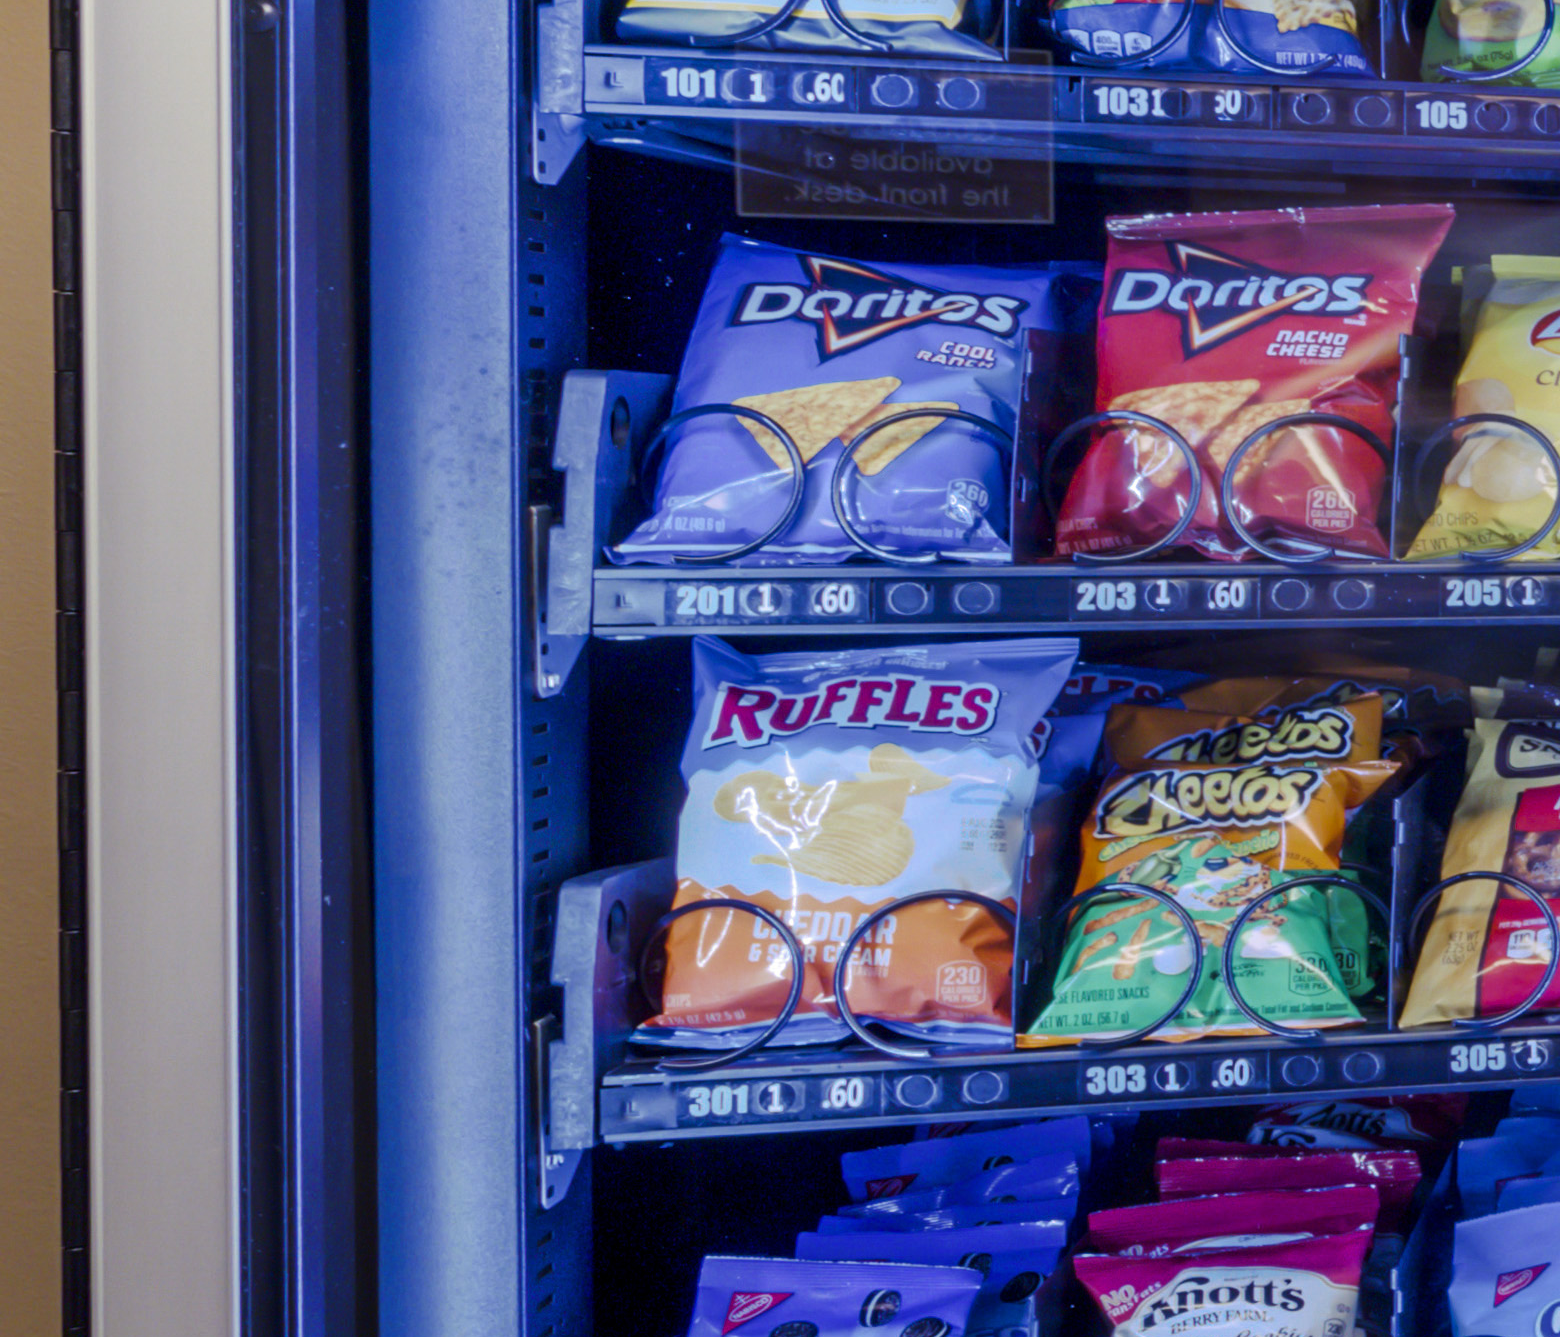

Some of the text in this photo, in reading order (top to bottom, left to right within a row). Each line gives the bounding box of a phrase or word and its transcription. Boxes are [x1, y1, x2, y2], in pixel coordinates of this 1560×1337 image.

[662, 69, 715, 99] 101
[1415, 100, 1467, 130] 105
[1110, 271, 1369, 313] Doritos
[738, 283, 1023, 333] Doritos
[939, 341, 996, 361] COOL
[1266, 343, 1346, 359] CHEESE
[1276, 330, 1349, 345] NACHO
[915, 349, 995, 370] RANCH
[676, 585, 735, 616] 201
[1076, 581, 1137, 611] 203
[711, 678, 994, 743] RUFFLES
[1098, 767, 1309, 837] Cheetos
[1085, 1064, 1147, 1095] 303
[1140, 1275, 1306, 1333] Knott's
[1170, 1312, 1222, 1335] BERRY
